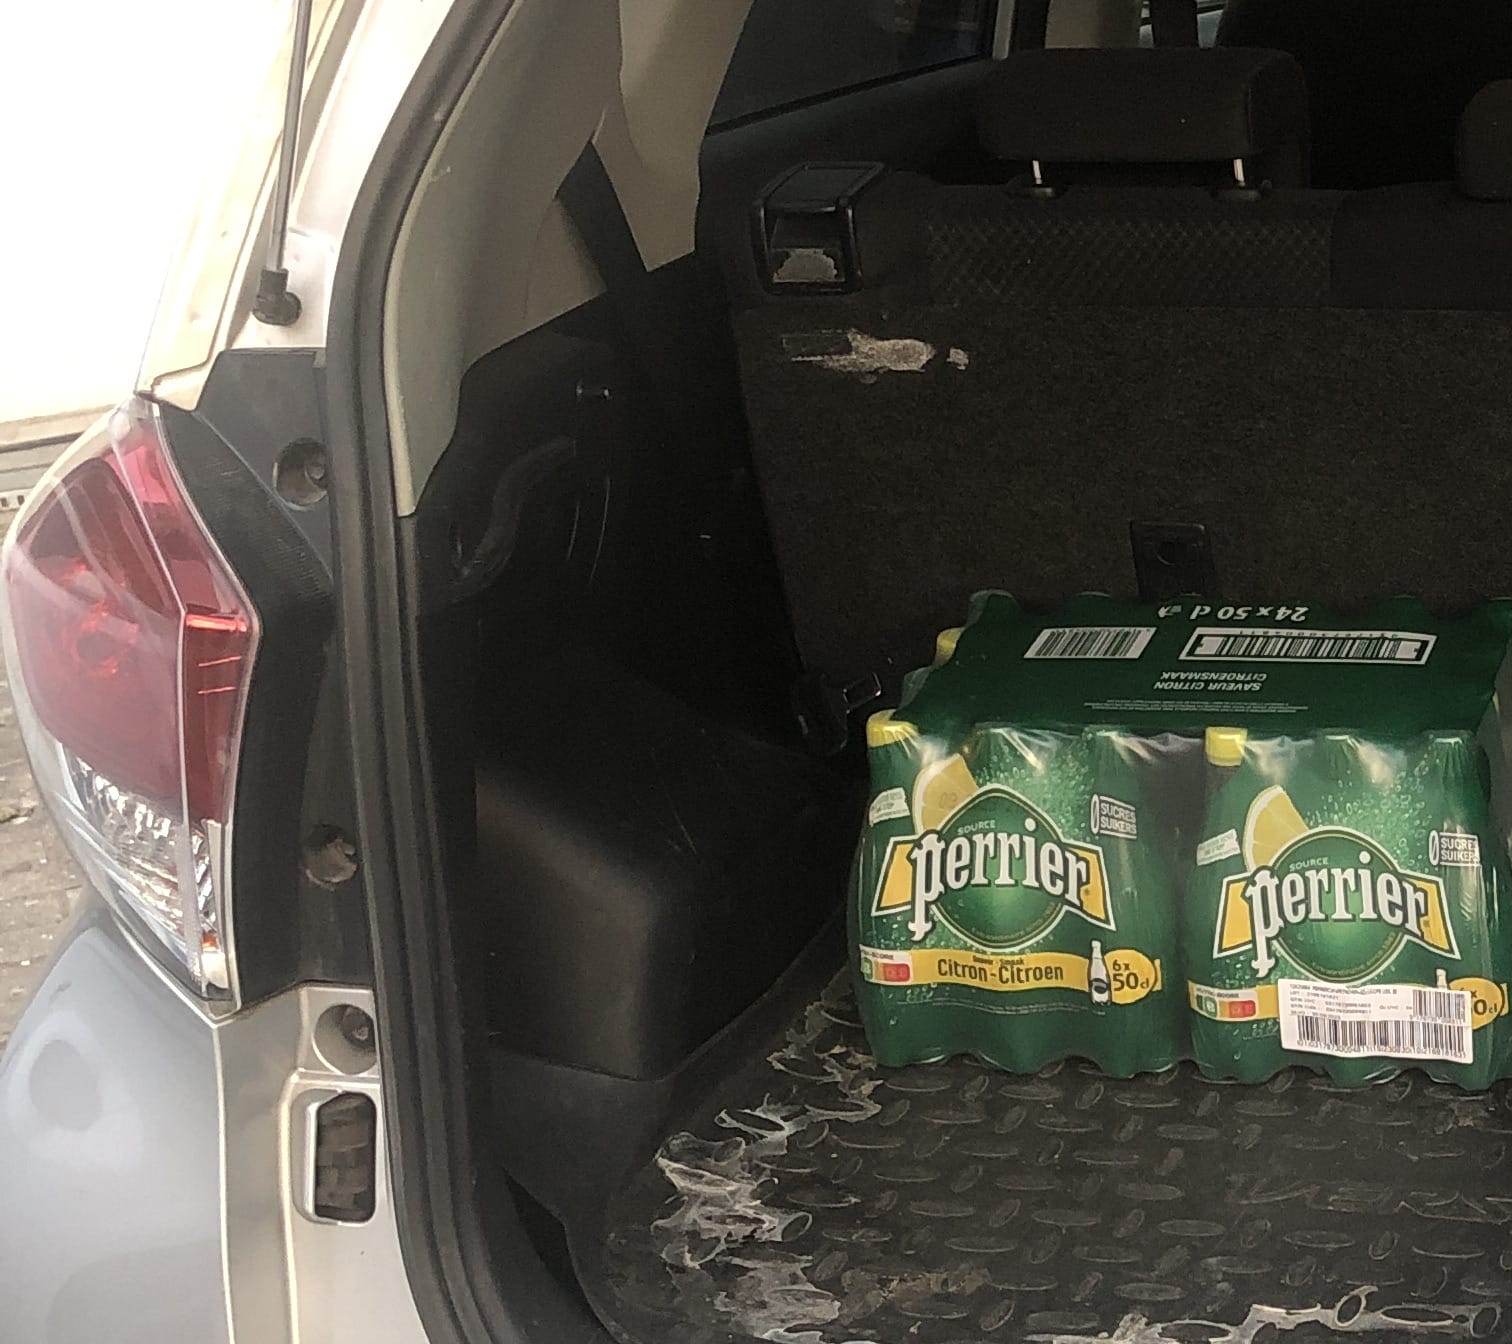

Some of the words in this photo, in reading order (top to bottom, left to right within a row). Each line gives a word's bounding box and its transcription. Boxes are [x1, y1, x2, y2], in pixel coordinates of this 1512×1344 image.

[1189, 605, 1211, 620] cl
[1217, 606, 1252, 620] 50
[1256, 606, 1273, 616] x
[1275, 606, 1309, 622] 24
[1160, 671, 1267, 681] CITROENSMAAK
[1153, 681, 1205, 691] CITRON
[1208, 682, 1263, 691] SAVEUR
[1101, 803, 1136, 823] SUCRES
[957, 819, 996, 836] SOURCE
[1289, 857, 1329, 872] SOURCE
[908, 818, 1087, 941] perrier
[1246, 851, 1425, 978] perrier
